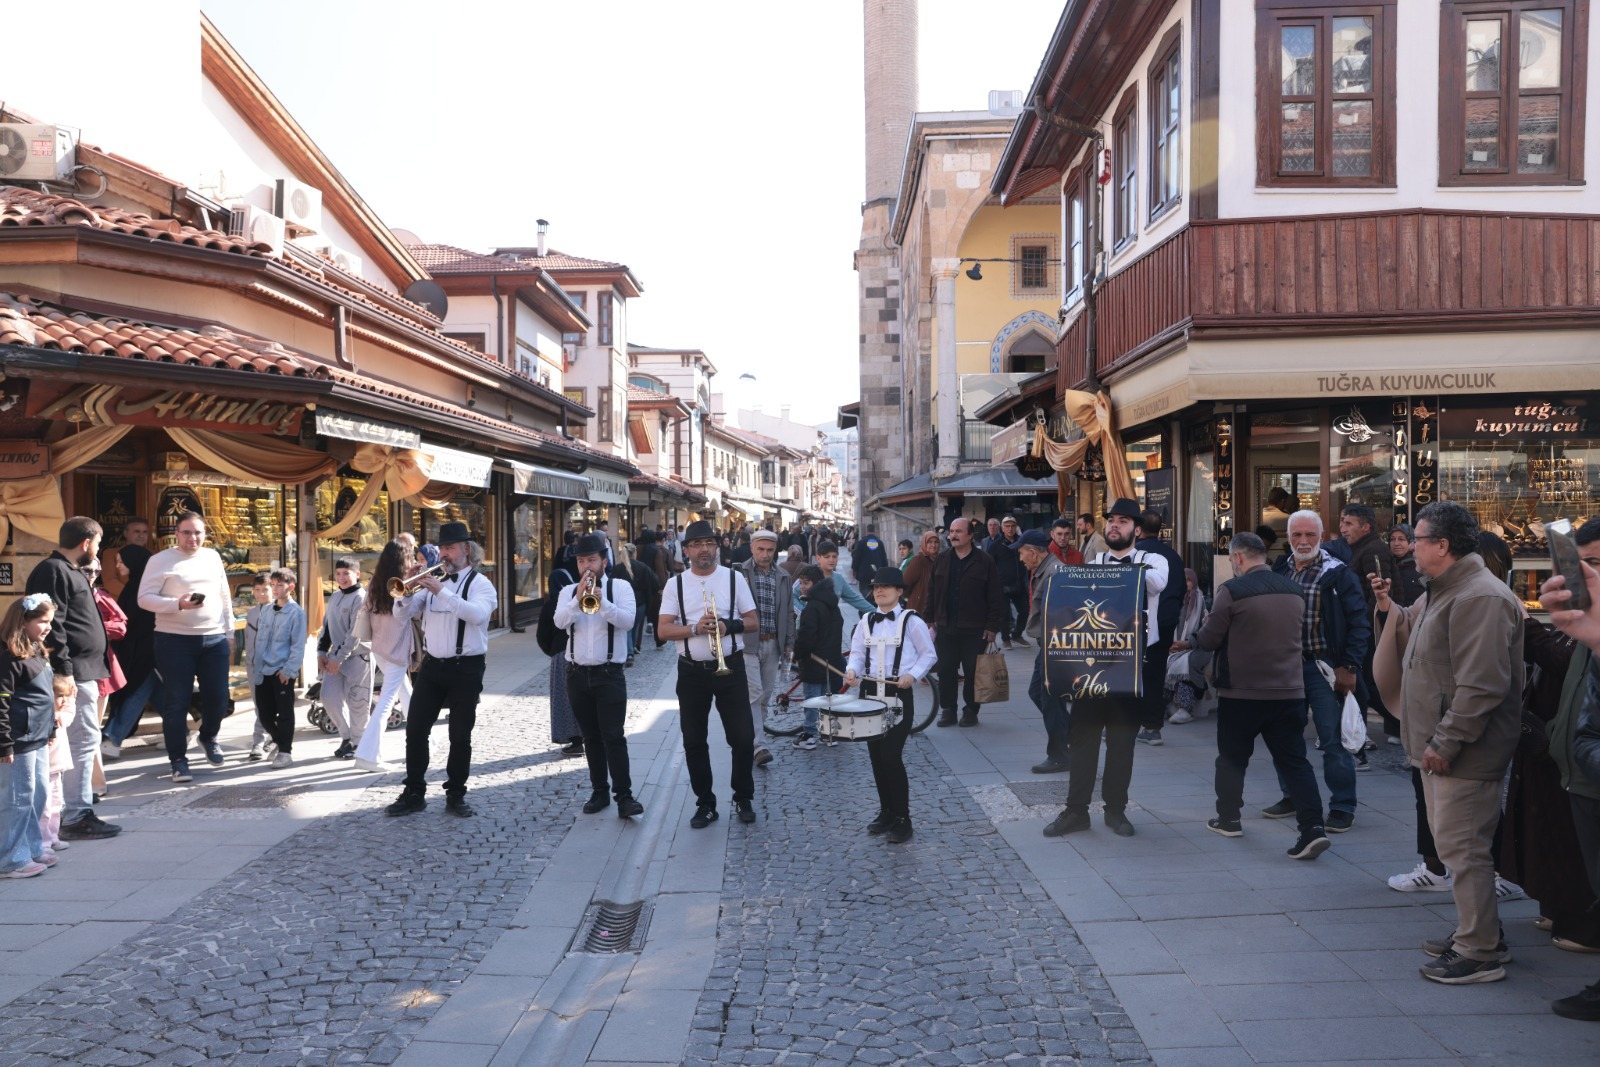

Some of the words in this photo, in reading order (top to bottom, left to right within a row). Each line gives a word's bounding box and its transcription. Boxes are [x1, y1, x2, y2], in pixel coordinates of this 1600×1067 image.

[1317, 373, 1375, 392] TUĞRA
[1380, 372, 1496, 391] KUYUMCULUK
[1514, 402, 1577, 420] tuğra
[1474, 418, 1588, 437] kuyumcul
[1415, 423, 1435, 504] tuğ
[1393, 430, 1408, 524] tuğr
[1048, 631, 1135, 650] ALTINFEST
